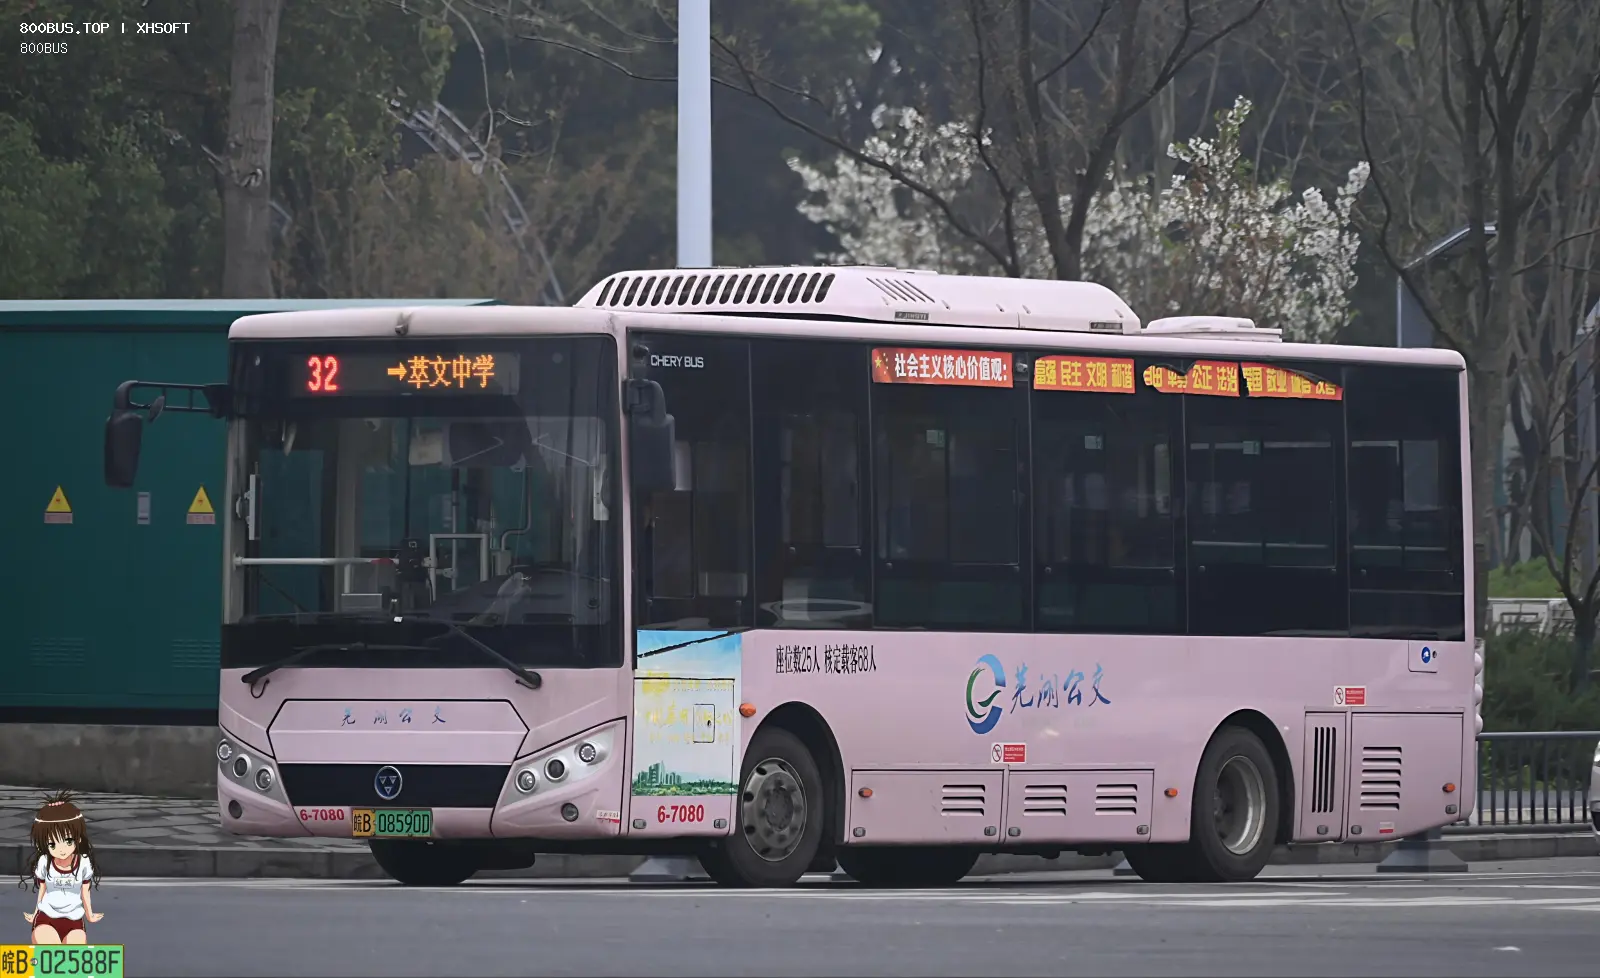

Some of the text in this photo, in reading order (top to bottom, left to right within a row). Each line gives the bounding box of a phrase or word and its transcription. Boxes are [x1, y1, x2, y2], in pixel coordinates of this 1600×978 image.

[308, 356, 338, 391] 32
[407, 354, 495, 389] 萃文中学
[650, 354, 704, 368] CHERY BUS
[1035, 359, 1133, 389] 富强 民主 文明 和谐
[1192, 364, 1213, 390] 公正
[1217, 366, 1238, 392] 法治
[776, 644, 877, 674] 座位数25人 核定载客68人
[1010, 662, 1111, 714] 芜湖公交
[300, 808, 345, 821] 6-7080
[657, 804, 705, 823] 6-7080
